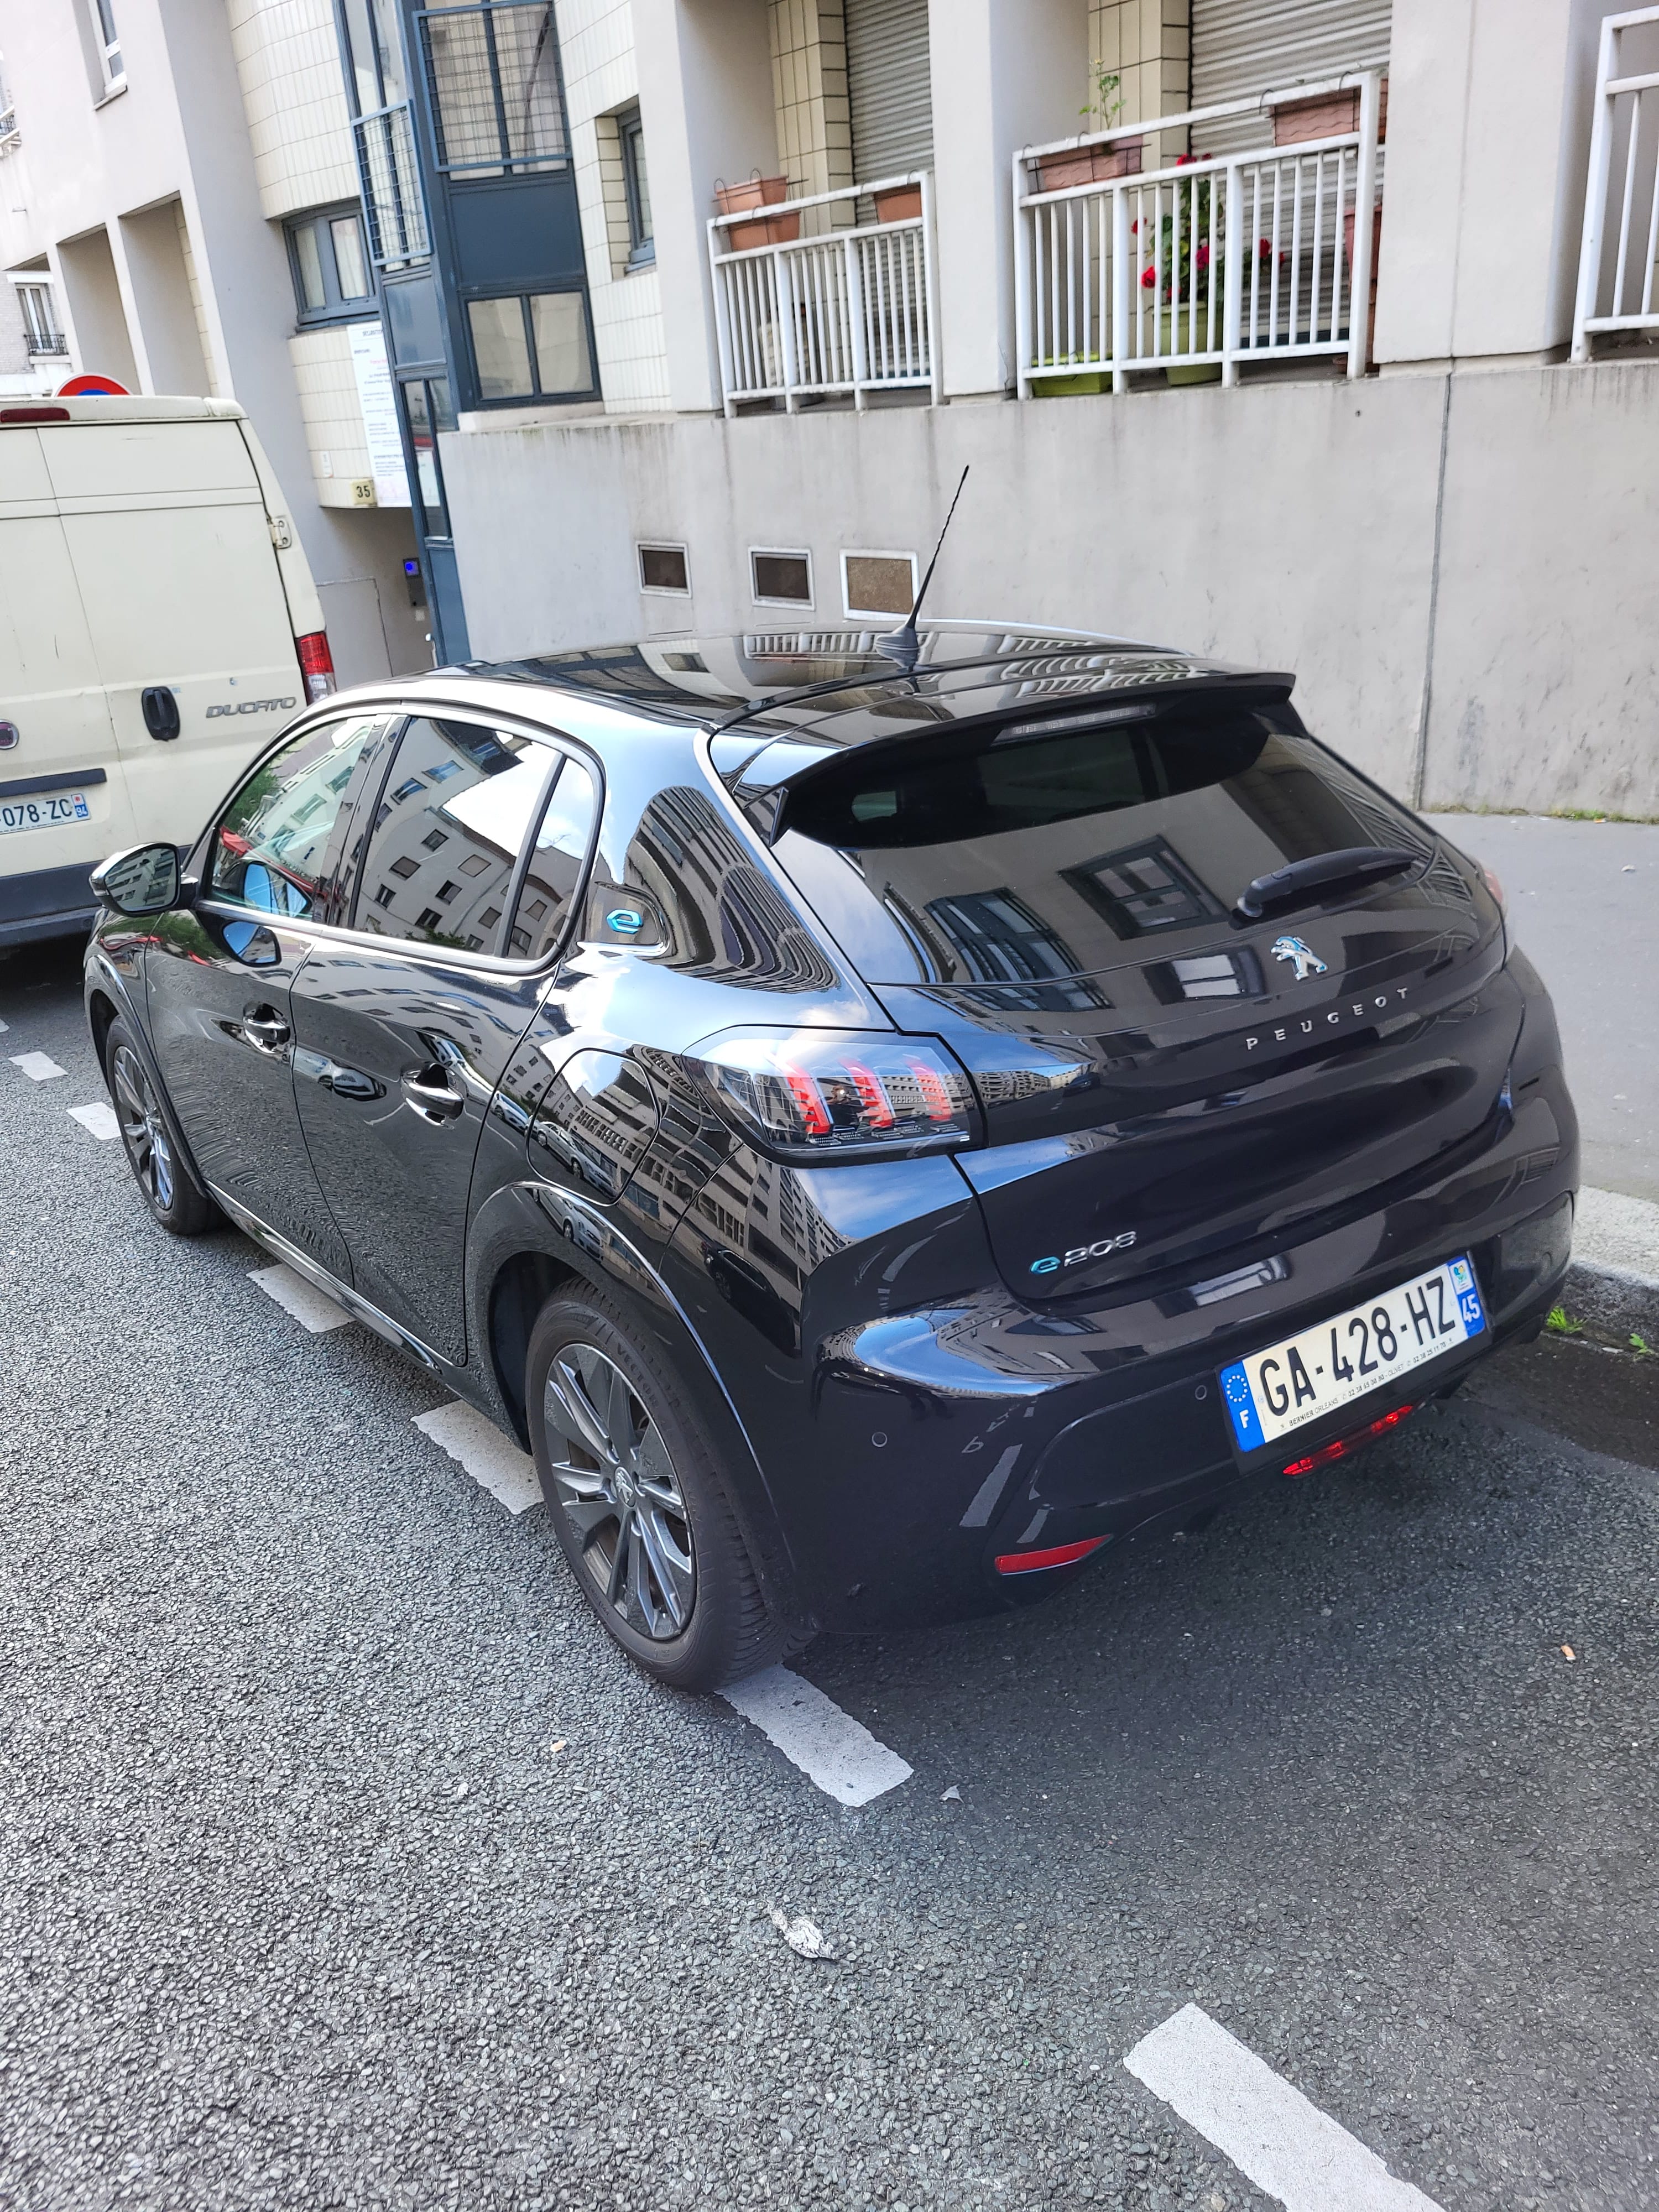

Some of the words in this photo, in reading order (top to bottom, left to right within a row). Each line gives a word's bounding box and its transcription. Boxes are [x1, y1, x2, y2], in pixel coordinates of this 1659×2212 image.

[356, 486, 370, 498] 35
[206, 697, 297, 718] DUCATO
[0, 799, 72, 826] 078-ZC
[76, 806, 87, 816] 94
[607, 909, 643, 935] e
[1246, 987, 1408, 1050] PEUGEOT
[1462, 1293, 1481, 1323] 45
[1260, 1276, 1455, 1416] GA-428-HZ
[1239, 1409, 1249, 1429] F
[1289, 1410, 1313, 1426] BERNIER
[1314, 1397, 1339, 1414] ORLEANS
